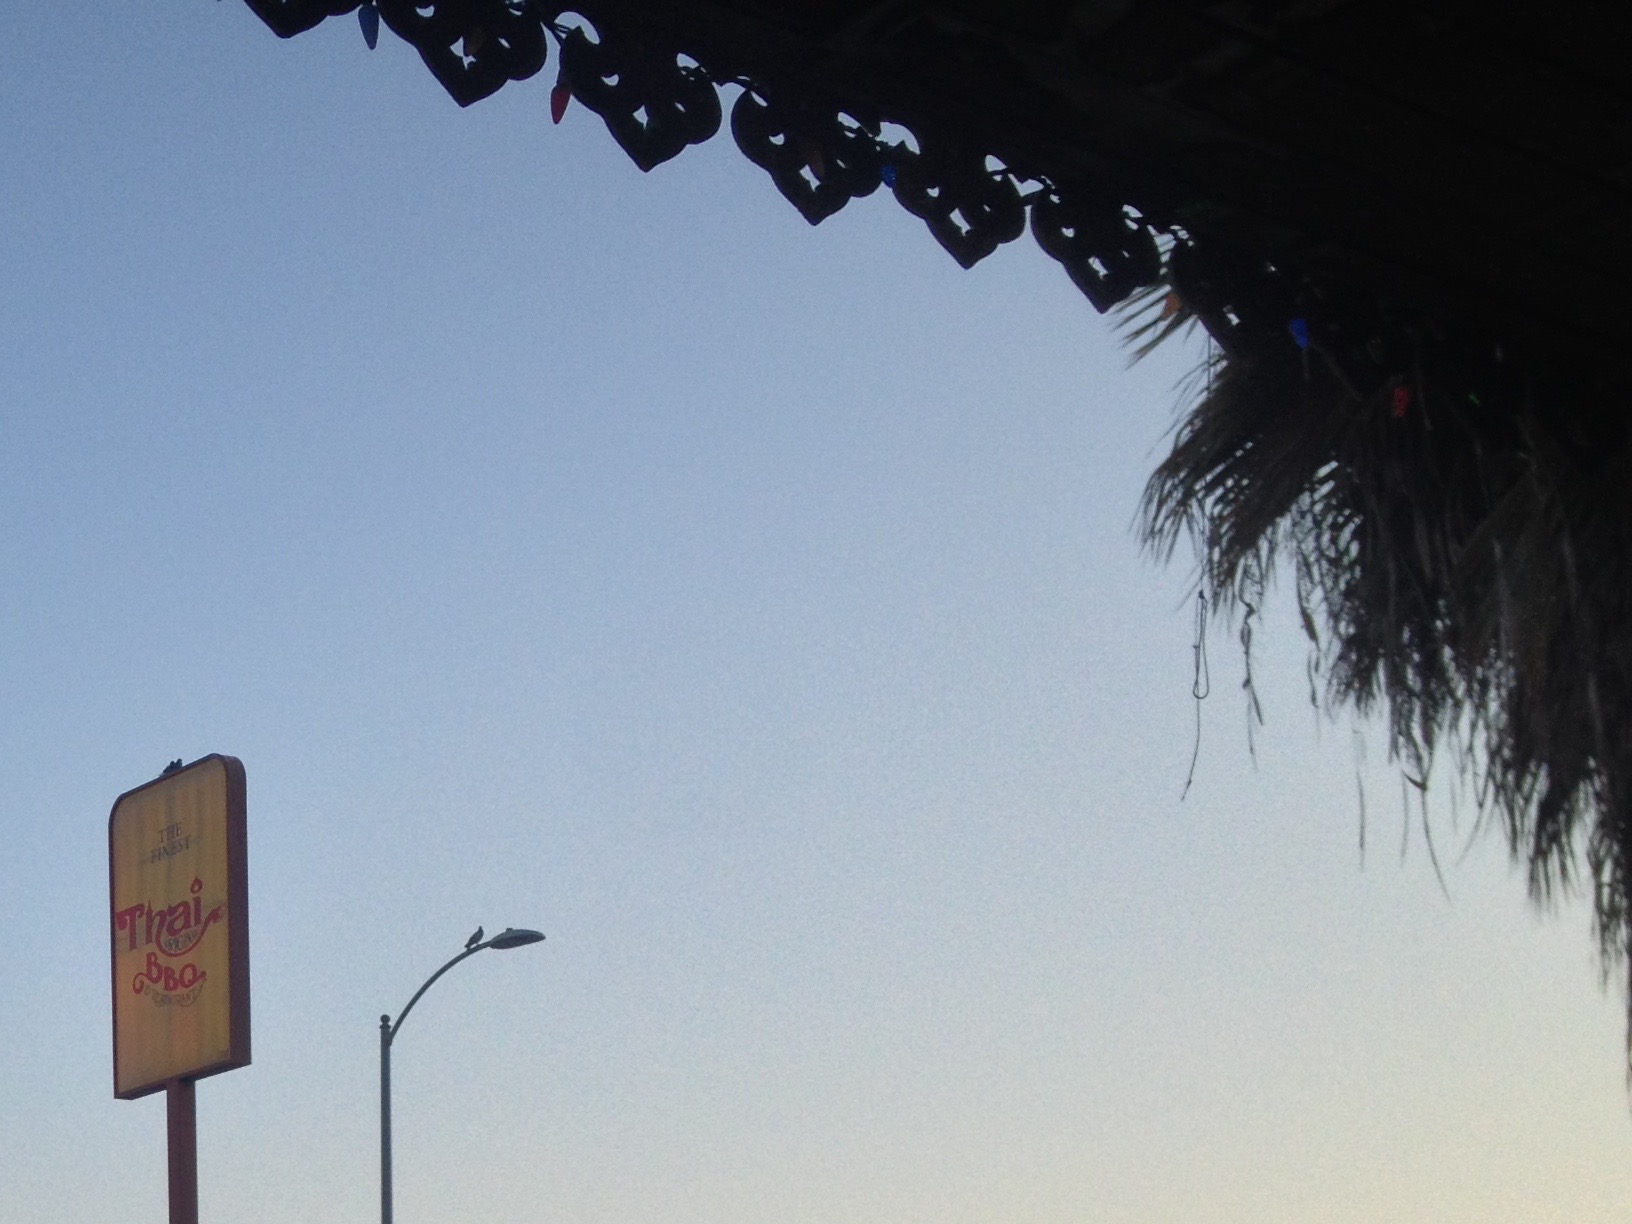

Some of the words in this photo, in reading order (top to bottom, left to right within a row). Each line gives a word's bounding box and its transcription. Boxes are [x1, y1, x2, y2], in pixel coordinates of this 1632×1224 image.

[150, 834, 191, 863] FINEST
[158, 821, 182, 843] THE
[116, 877, 218, 956] Thai
[133, 951, 207, 995] BBQ
